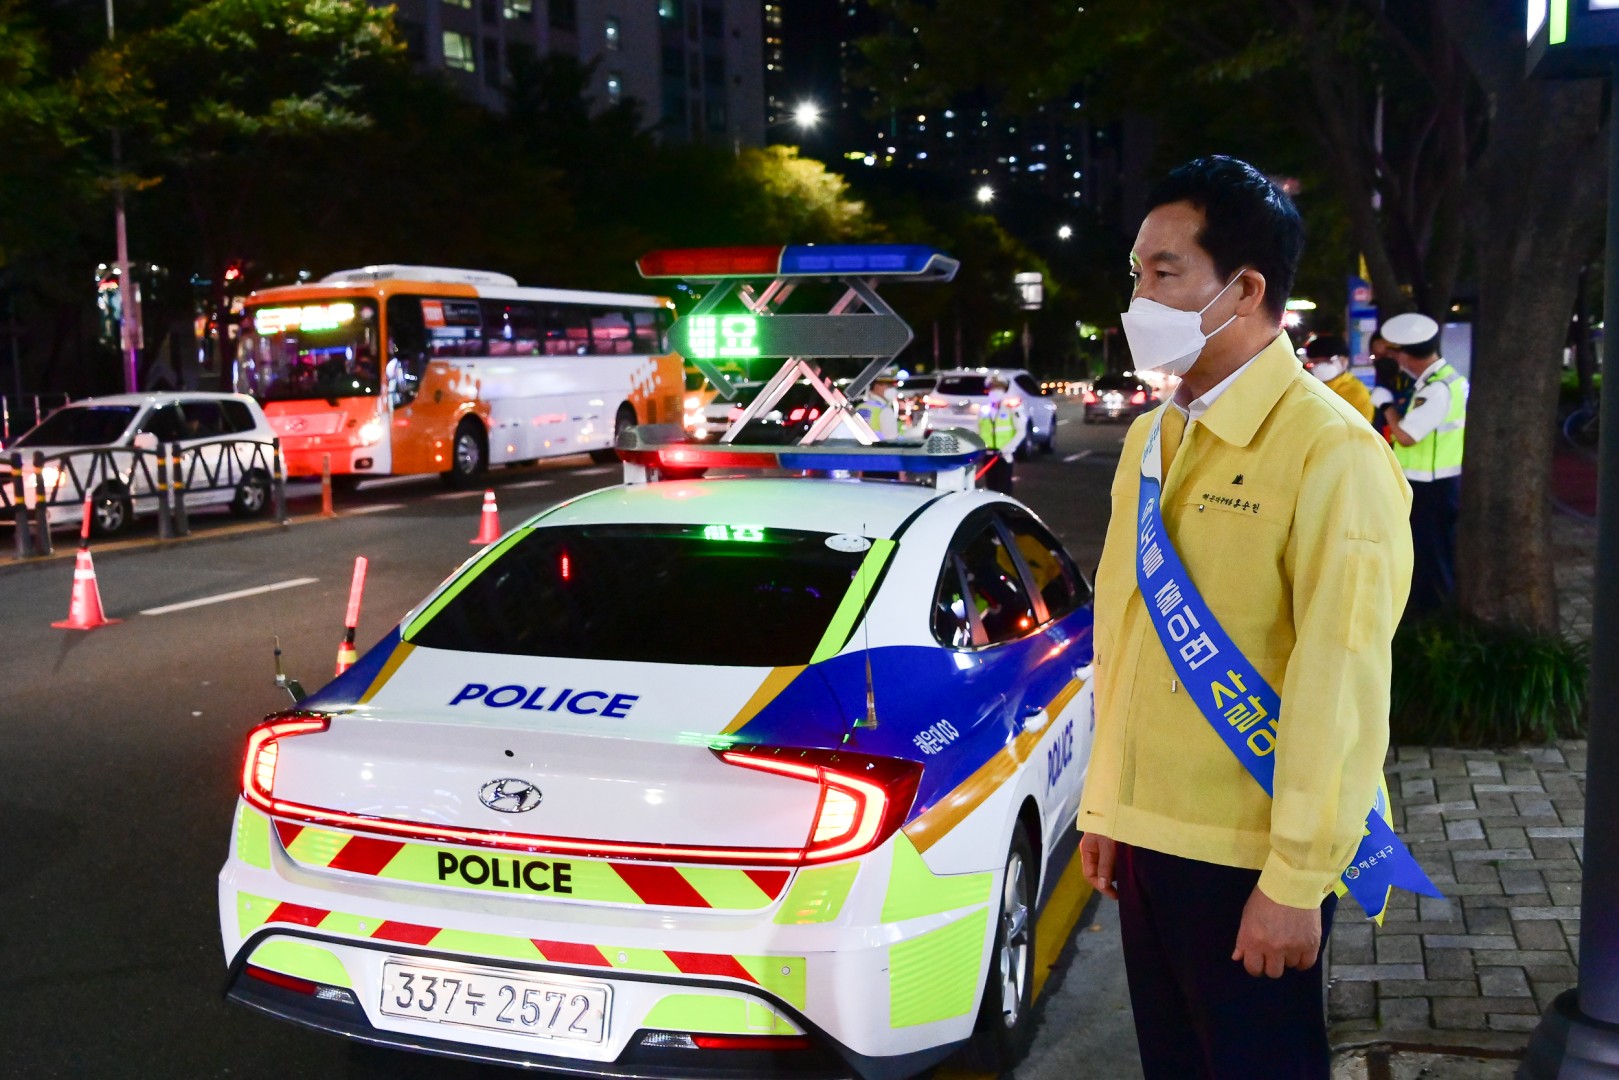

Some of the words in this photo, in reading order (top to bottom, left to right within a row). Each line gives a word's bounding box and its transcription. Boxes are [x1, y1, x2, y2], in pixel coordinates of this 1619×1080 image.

[1154, 578, 1220, 671] 줄이면
[448, 683, 640, 719] POLICE
[1046, 719, 1074, 796] POLICE
[437, 851, 573, 894] POLICE
[1358, 844, 1394, 870] 해운대구
[395, 972, 487, 1017] 337누
[495, 985, 590, 1034] 2572
